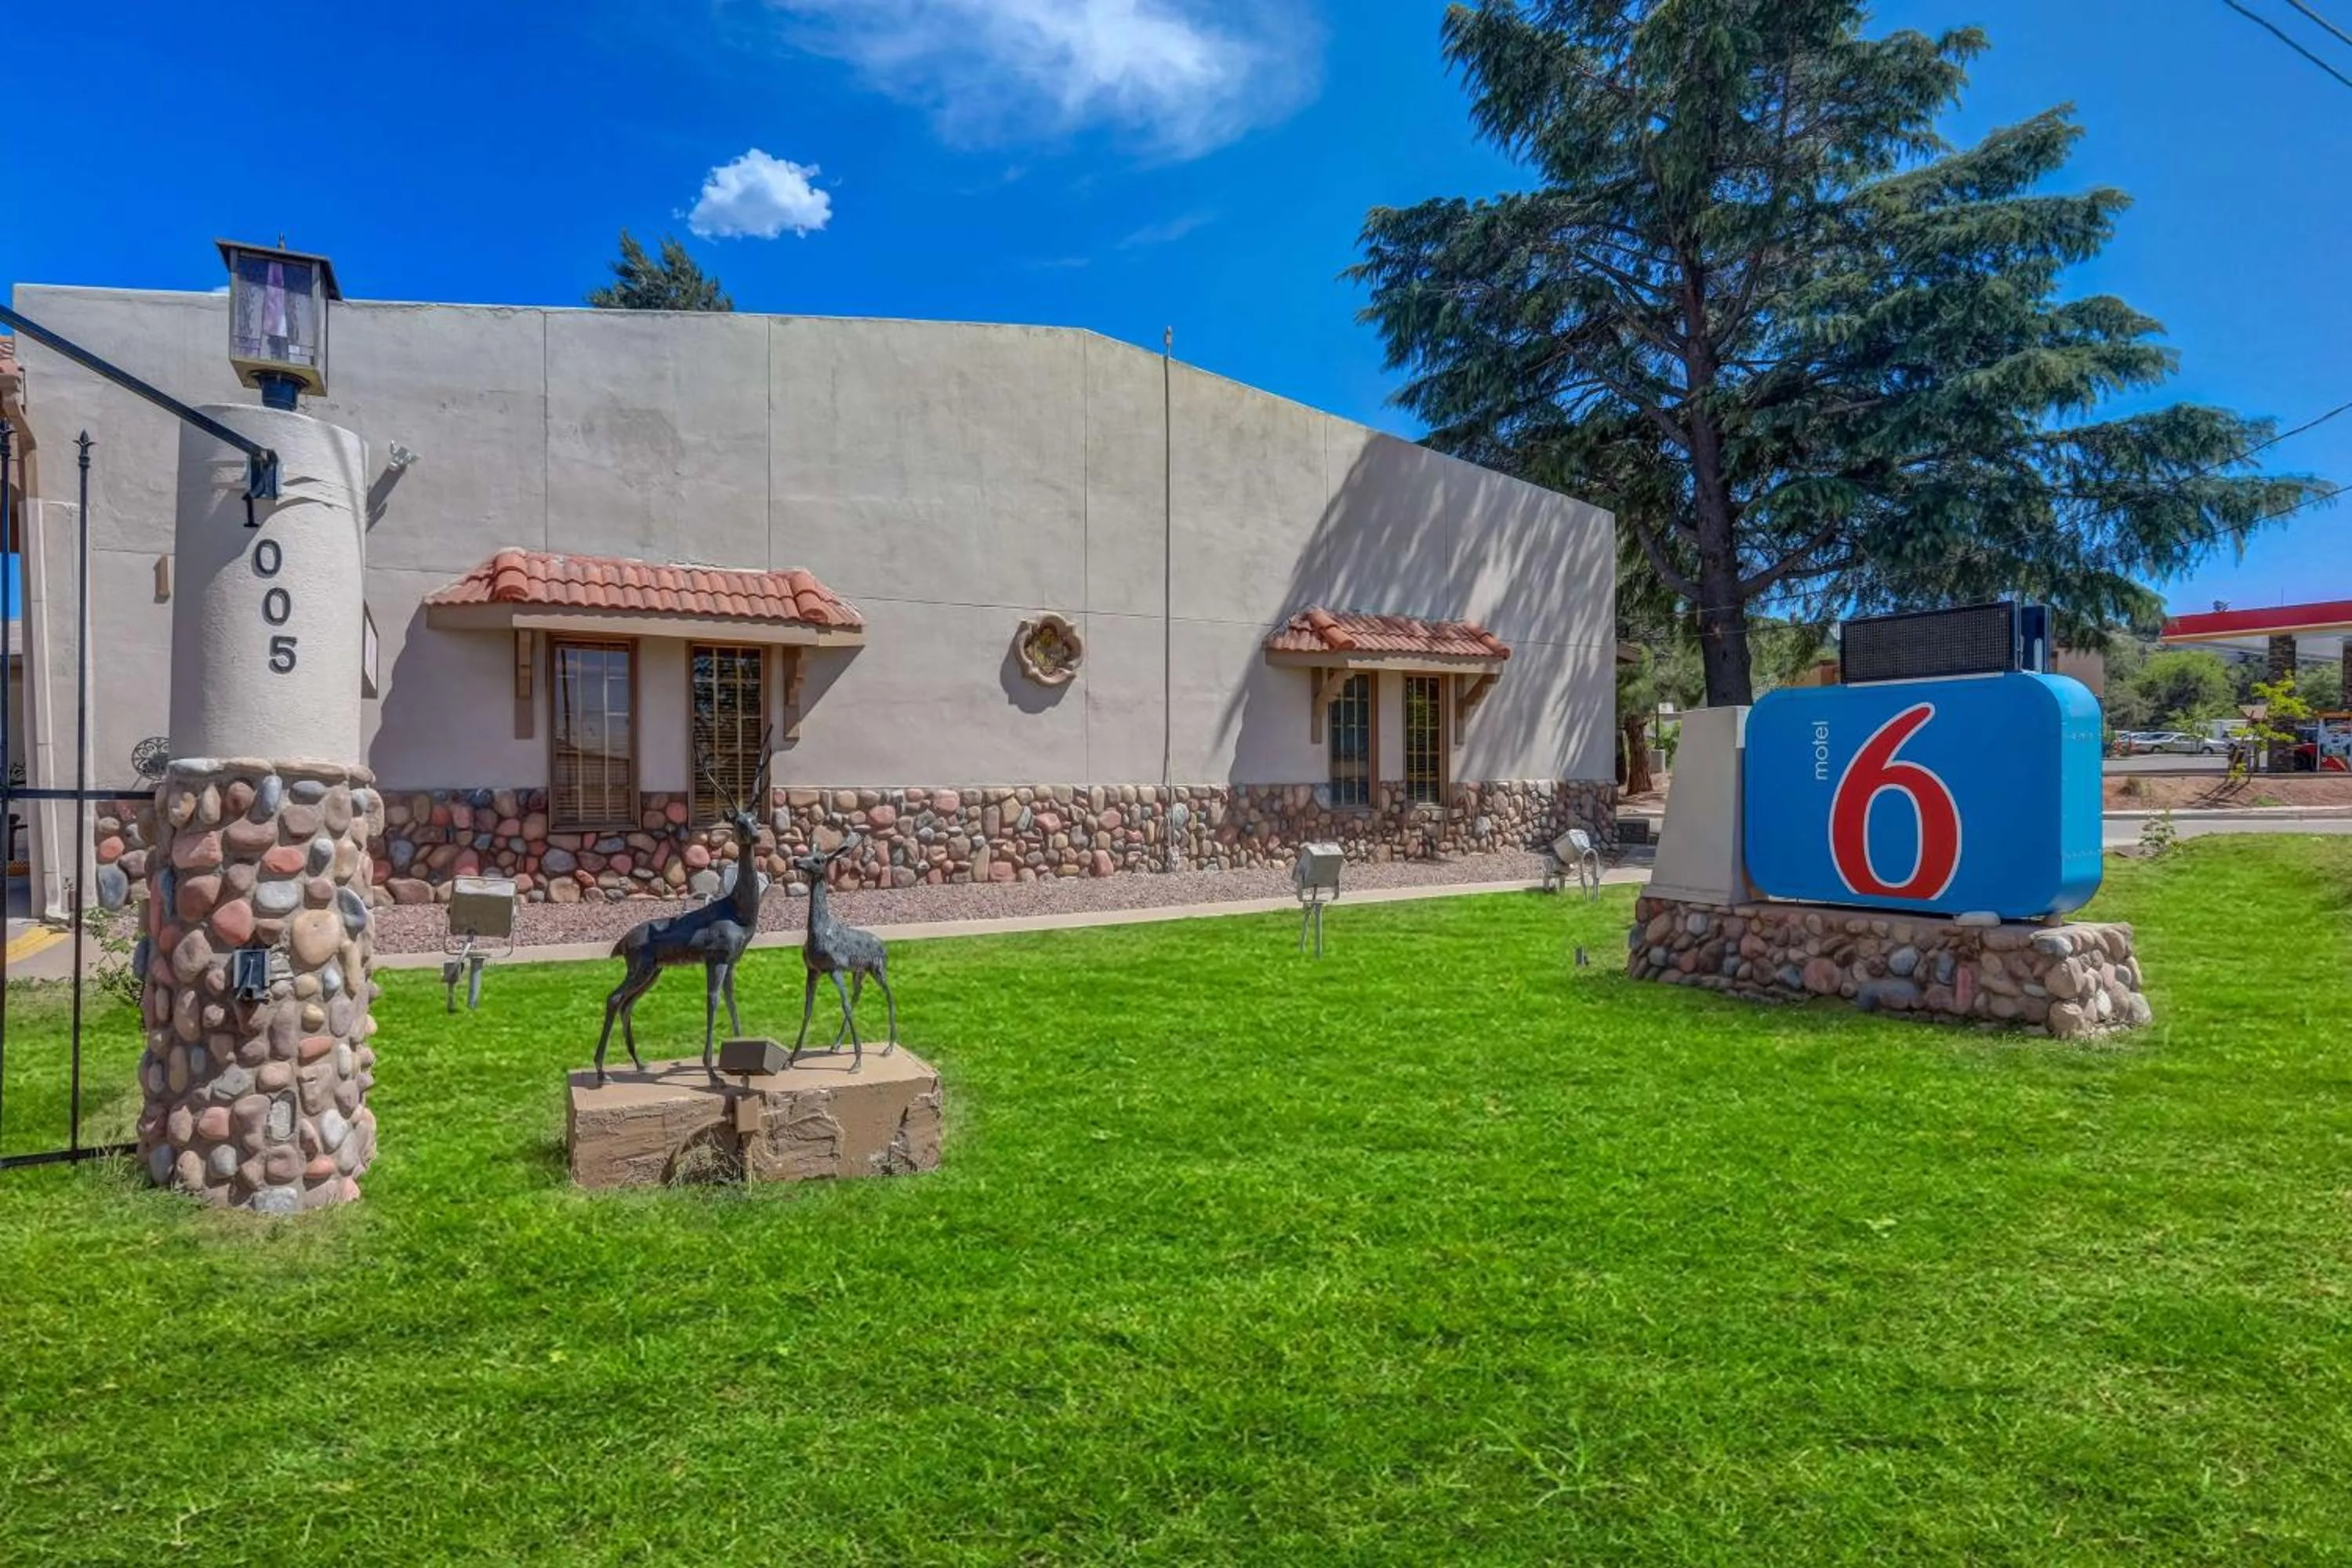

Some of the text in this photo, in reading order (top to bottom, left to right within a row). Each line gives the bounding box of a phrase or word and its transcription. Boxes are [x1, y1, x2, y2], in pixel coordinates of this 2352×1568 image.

[241, 494, 297, 674] 1005
[1812, 702, 1962, 900] motel 6
